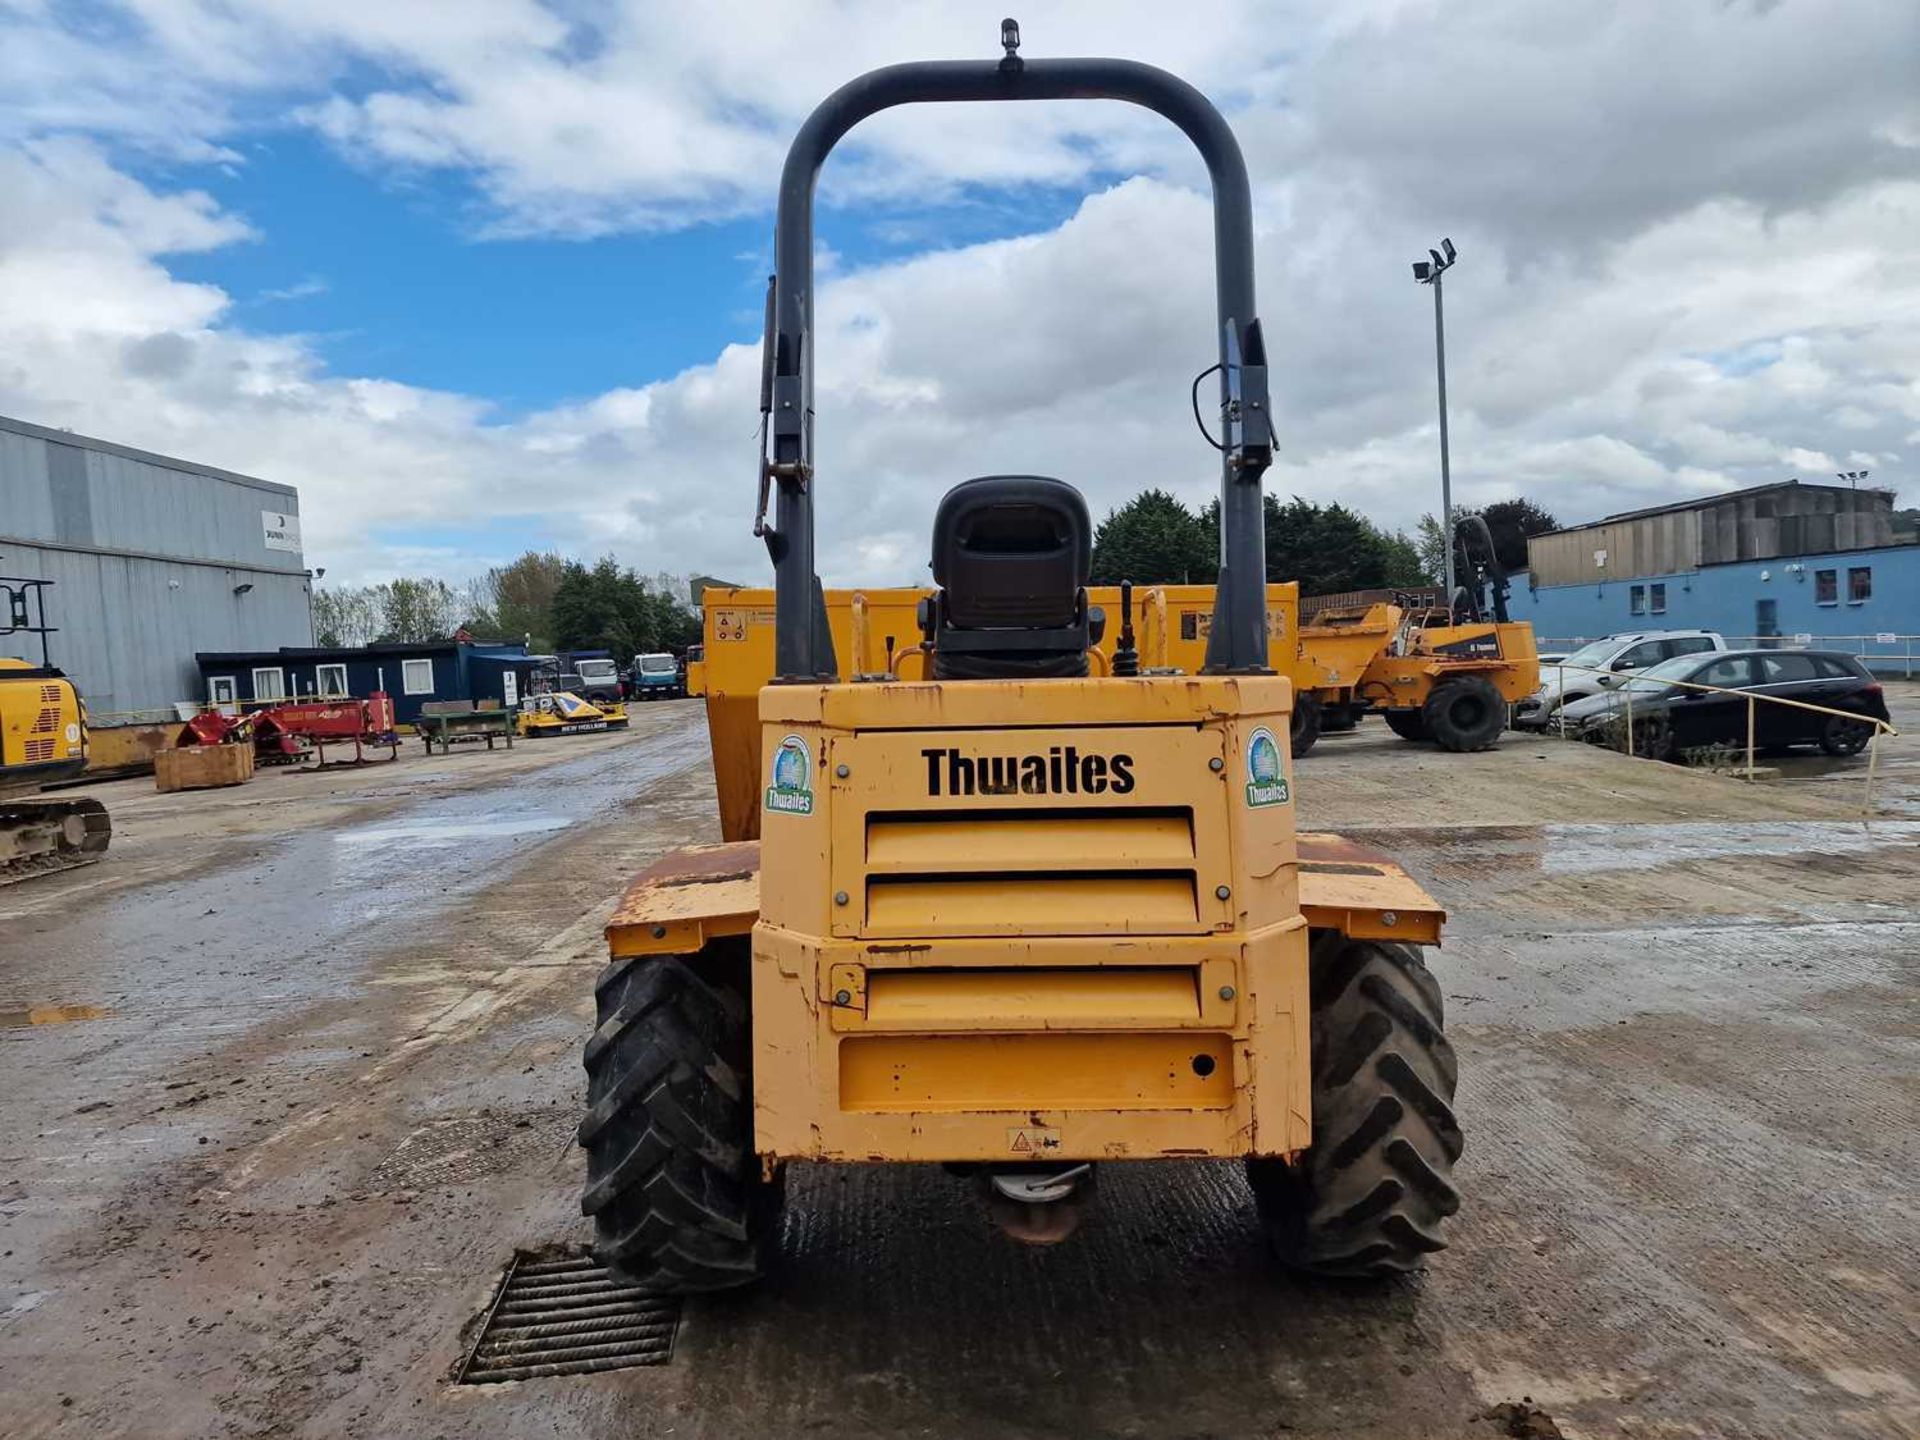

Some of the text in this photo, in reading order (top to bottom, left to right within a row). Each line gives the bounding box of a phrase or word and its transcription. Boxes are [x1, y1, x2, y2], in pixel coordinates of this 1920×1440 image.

[921, 746, 1135, 796] Thwaites
[768, 788, 811, 812] Thwaites
[1248, 783, 1287, 804] Thwaites
